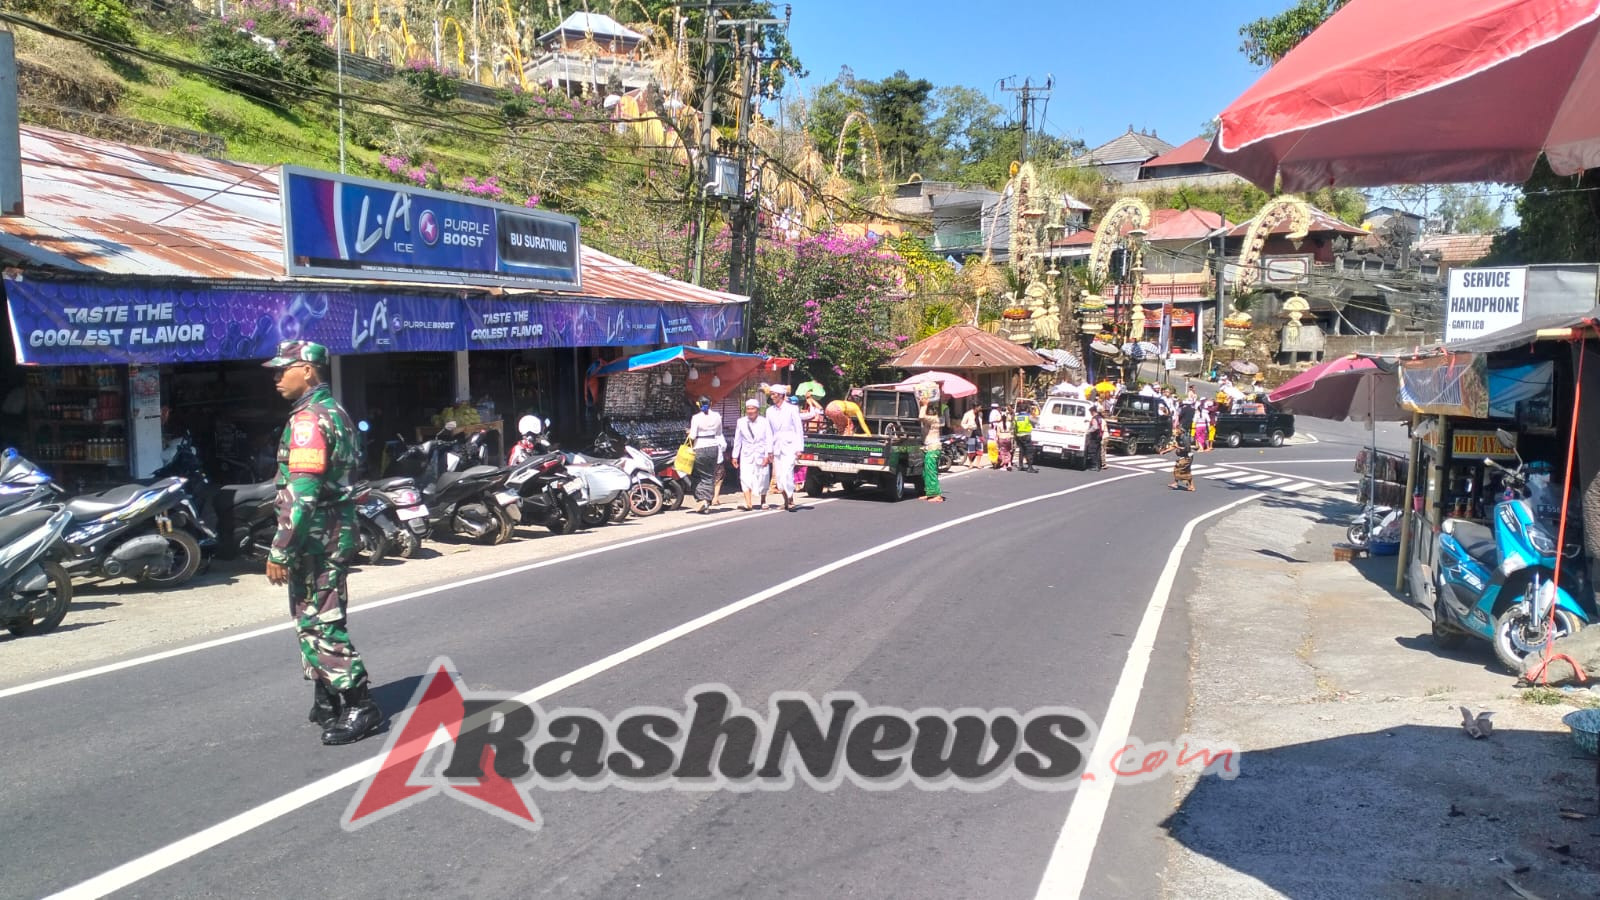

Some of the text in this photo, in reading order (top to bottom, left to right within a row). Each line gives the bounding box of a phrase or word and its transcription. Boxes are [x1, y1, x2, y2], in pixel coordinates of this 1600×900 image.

[444, 218, 490, 236] PURPLE
[393, 242, 414, 254] ICE
[443, 232, 485, 248] BOOST
[510, 232, 568, 253] BU SURATNING
[1463, 271, 1511, 288] SERVICE
[64, 302, 173, 324] TASTE THE
[1451, 297, 1520, 313] HANDPHONE
[482, 310, 529, 325] TASTE THE
[1452, 319, 1471, 329] GANTI
[29, 324, 205, 348] COOLEST FLAVOR
[471, 324, 543, 340] COOLEST FLAVOR
